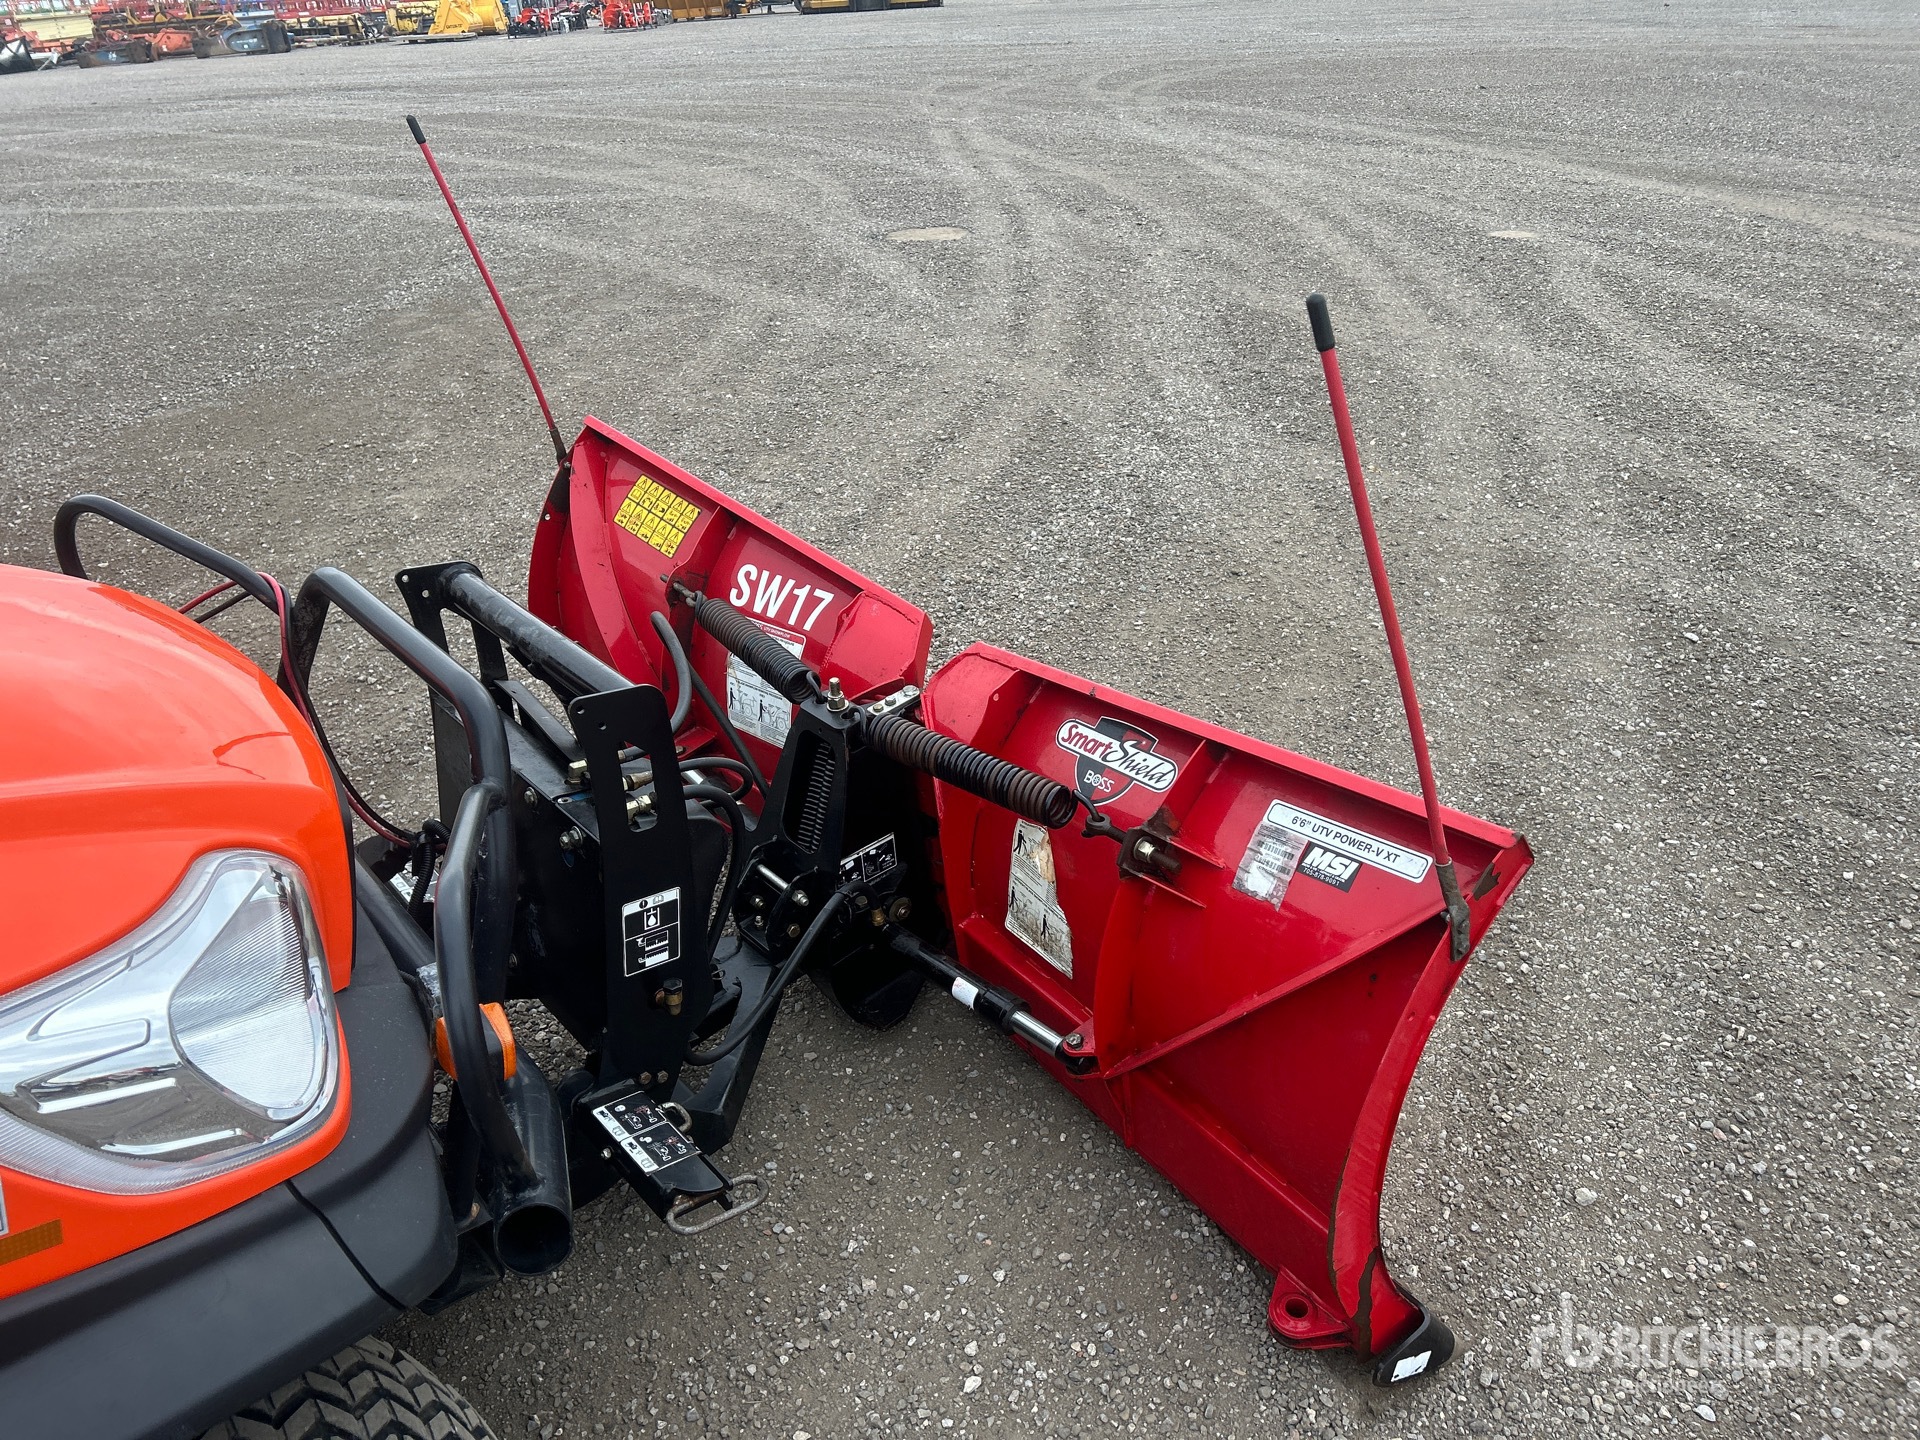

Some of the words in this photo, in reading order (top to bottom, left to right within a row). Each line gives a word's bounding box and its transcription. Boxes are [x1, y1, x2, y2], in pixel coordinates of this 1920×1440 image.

[730, 563, 834, 631] SW17
[1083, 769, 1115, 792] BOSS
[1312, 822, 1334, 838] UTV
[1332, 831, 1385, 858] POWER-V
[1383, 850, 1401, 864] XT
[1303, 846, 1360, 880] MSI
